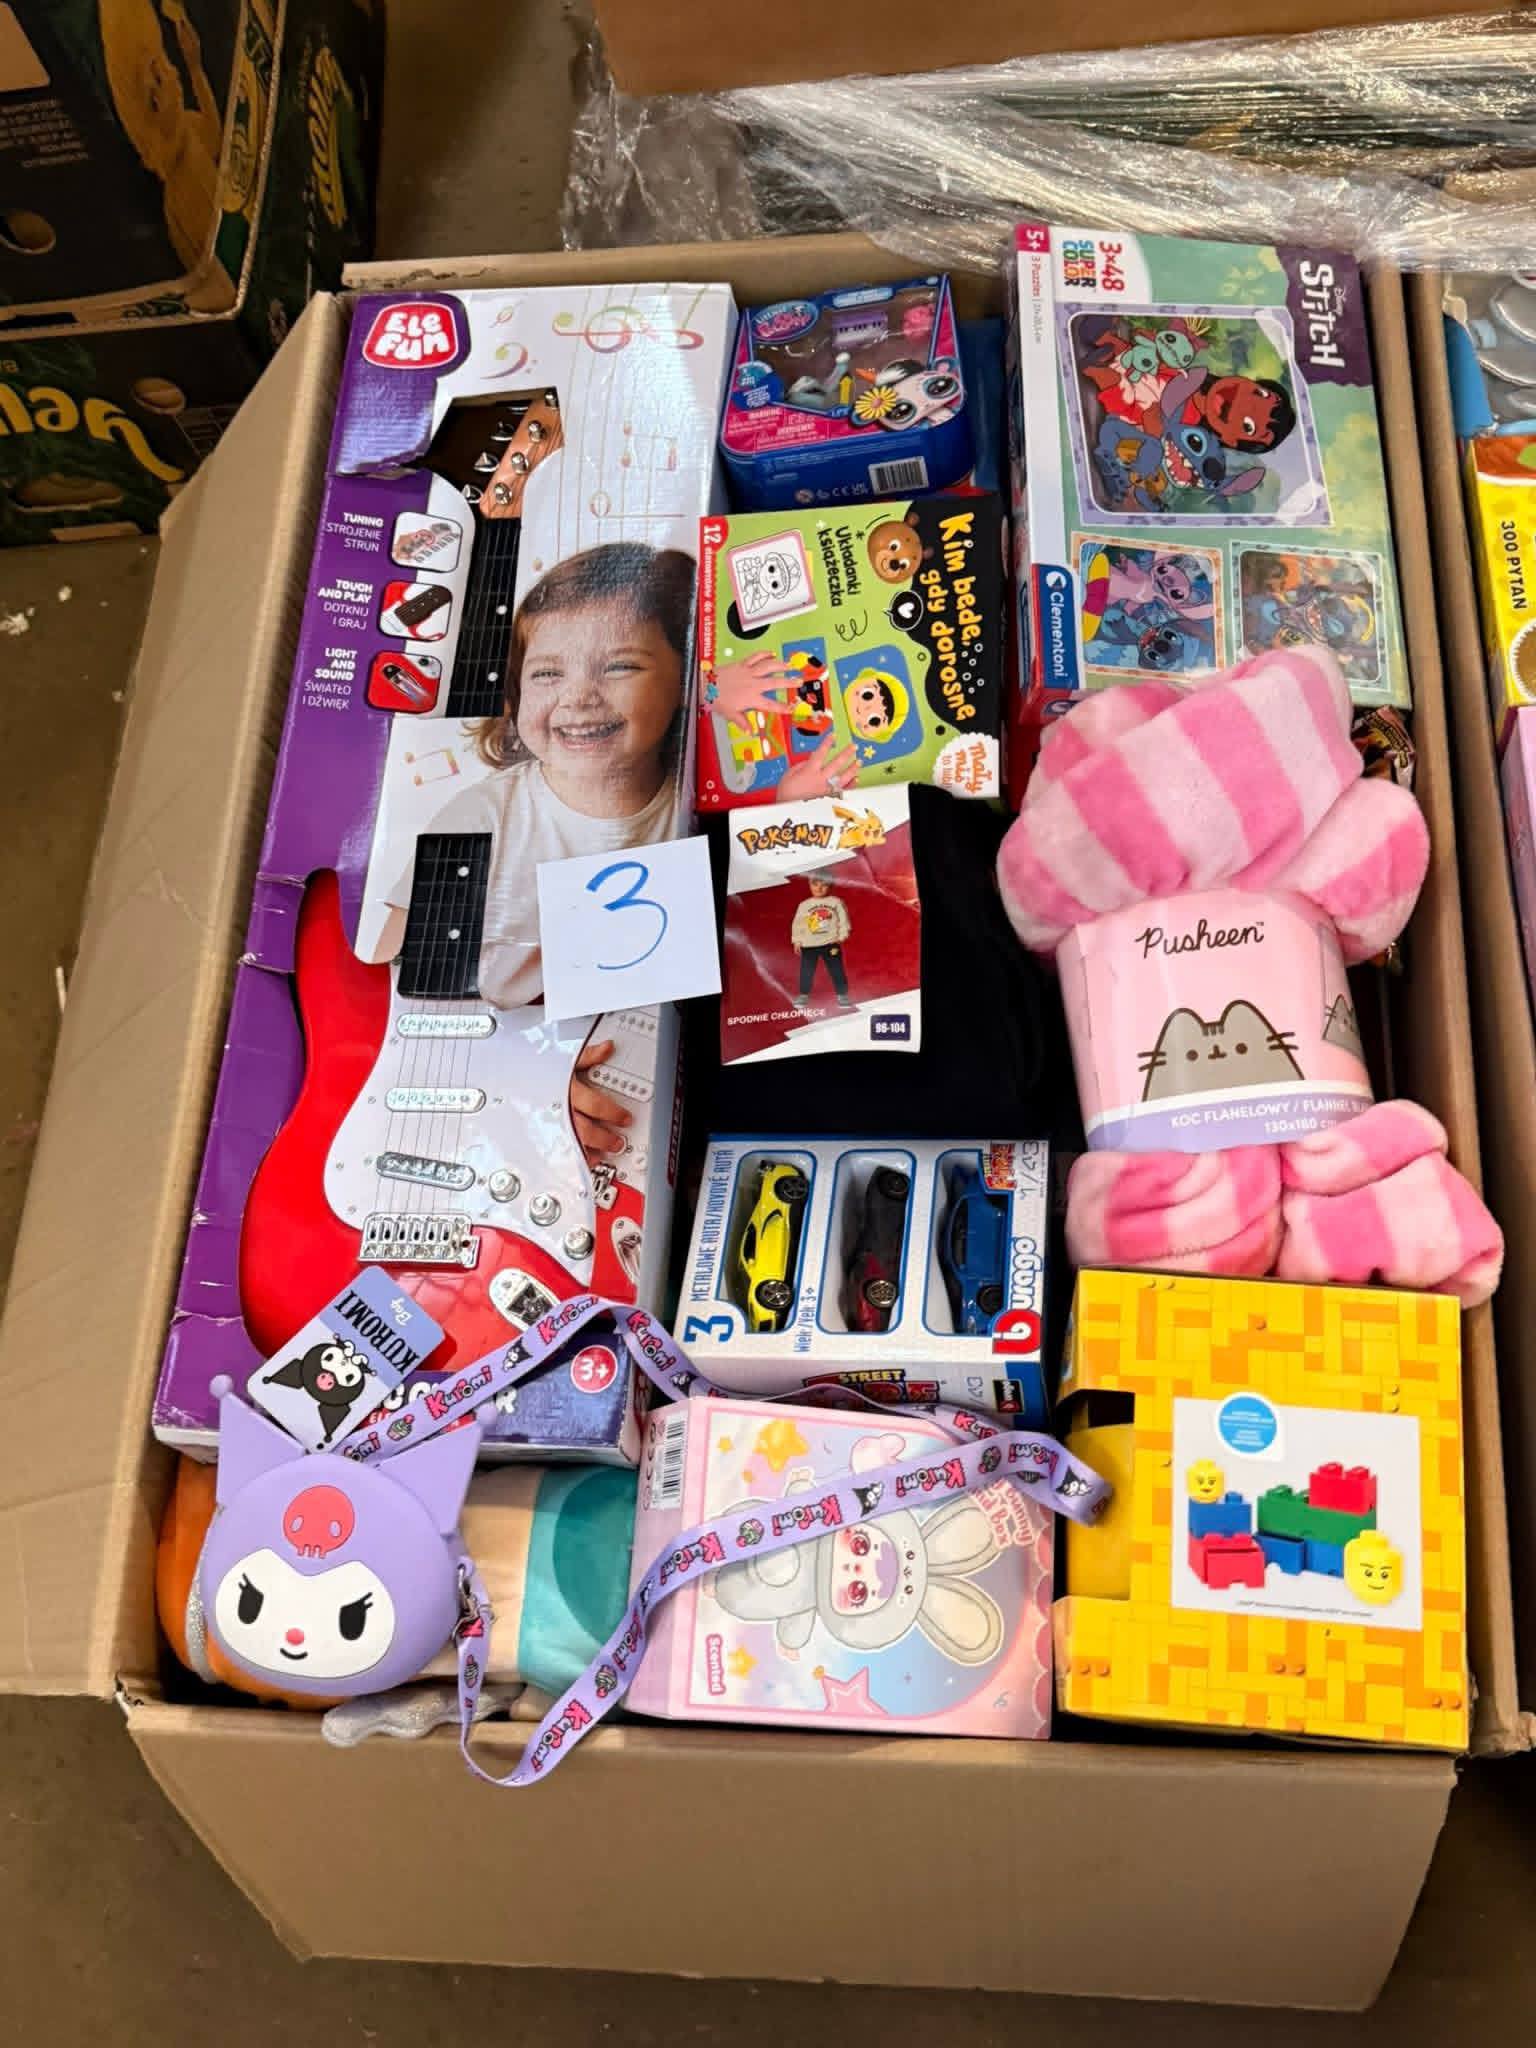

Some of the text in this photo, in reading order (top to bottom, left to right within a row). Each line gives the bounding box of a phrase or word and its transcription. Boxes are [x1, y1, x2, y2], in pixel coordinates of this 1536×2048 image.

[1026, 230, 1044, 249] 5+
[1062, 240, 1080, 286] COLOR
[1079, 240, 1096, 287] SUPER
[325, 522, 383, 540] STROJENIE
[343, 512, 384, 527] TUNING
[704, 525, 721, 544] 12
[344, 537, 380, 552] STRUN
[939, 512, 974, 572] Kim
[1501, 521, 1518, 552] 300
[318, 587, 372, 603] AND PLAY
[336, 579, 373, 593] TOUCH
[920, 569, 948, 612] gdy
[323, 602, 369, 617] DOTKNIJ
[338, 617, 367, 630] GRAJ
[1048, 592, 1068, 677] Clementoni
[325, 648, 357, 658] LIGHT
[331, 660, 355, 669] AND
[315, 669, 354, 681] SOUND
[585, 861, 668, 970] 3
[1135, 919, 1264, 959] Pusheen
[728, 1015, 768, 1026] SPODNIE
[1171, 1115, 1200, 1129] KOC
[1204, 1103, 1289, 1125] FLANELOWY
[690, 1247, 717, 1302] METALOWE
[334, 1289, 420, 1375] KUROMI
[537, 1295, 600, 1345] Kuromi
[683, 1315, 734, 1343] 3
[627, 1310, 677, 1372] Kuromi
[581, 1357, 608, 1381] 3+
[839, 1370, 903, 1382] STREET
[424, 1366, 493, 1419] Kuromi
[895, 1458, 967, 1498] Kuromi
[771, 1493, 842, 1537] Kuromi
[660, 1531, 726, 1585] Kuromi
[708, 1635, 723, 1694] Scented
[531, 1699, 592, 1772] Kuromi
